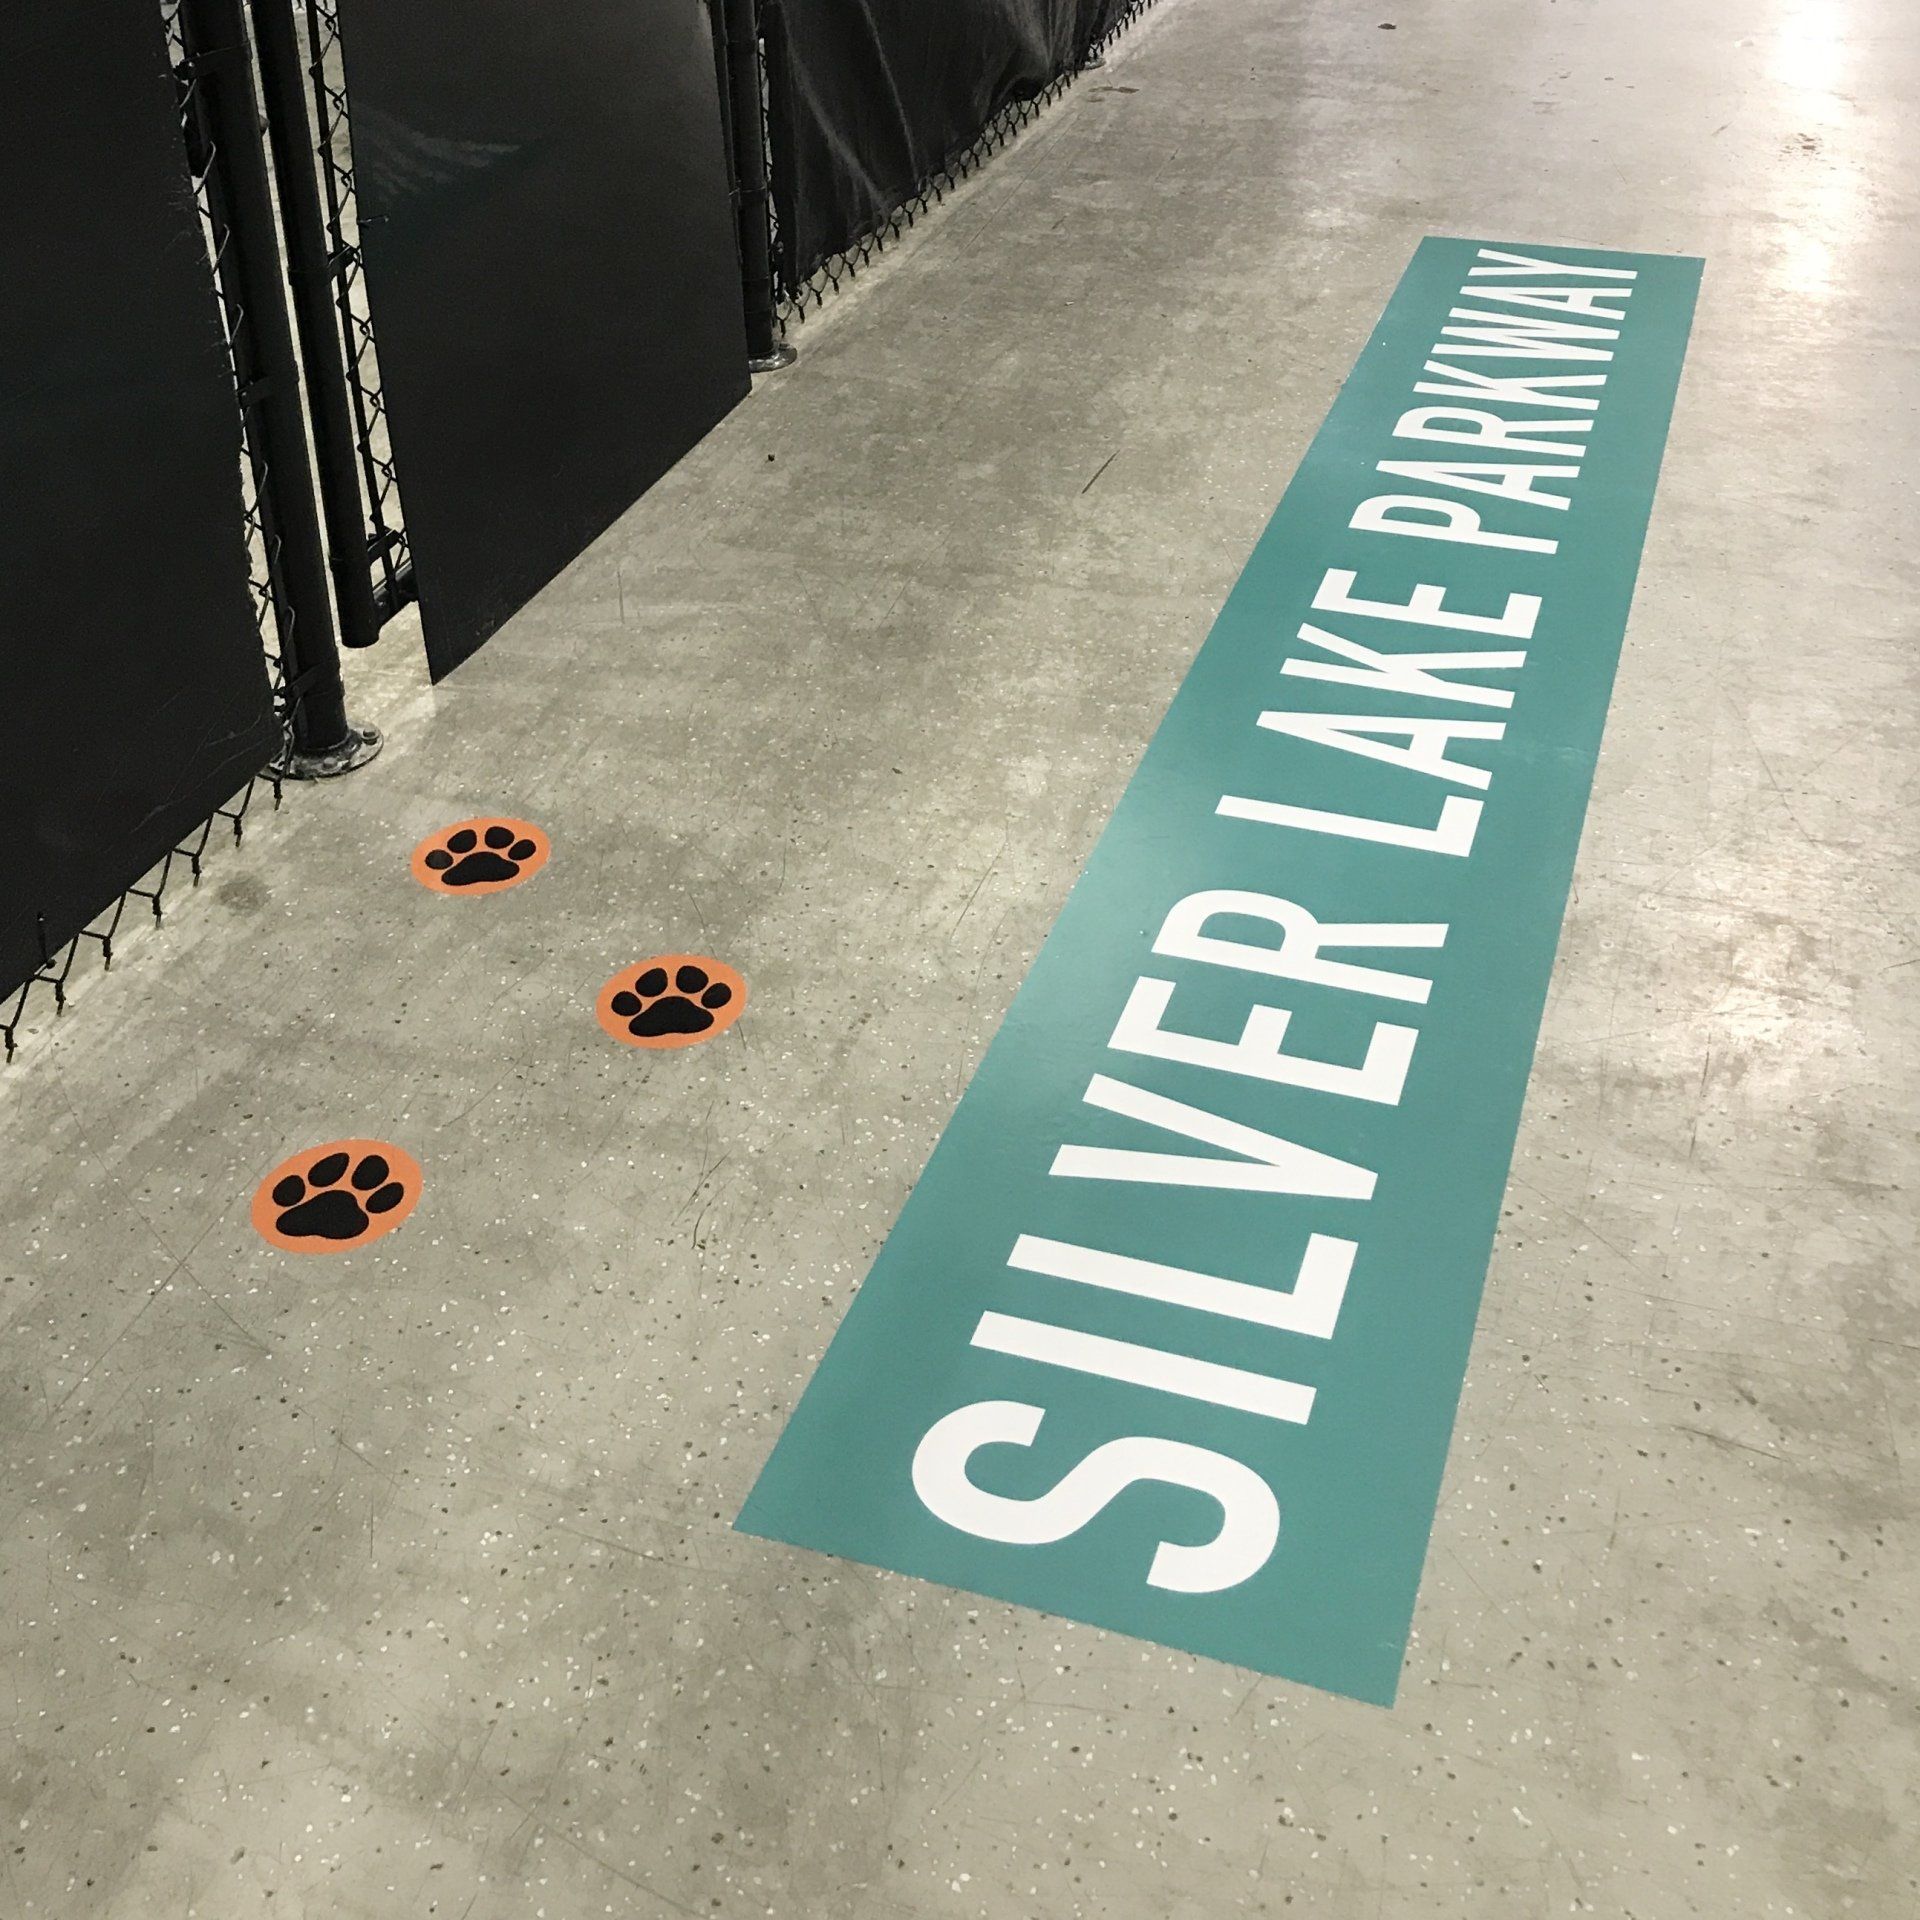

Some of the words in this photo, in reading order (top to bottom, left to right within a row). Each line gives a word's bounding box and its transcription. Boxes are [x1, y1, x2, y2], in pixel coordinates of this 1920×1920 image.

[1349, 249, 1639, 555] PARKWAY
[1214, 567, 1543, 858] LAKE
[911, 889, 1450, 1595] SILVER
